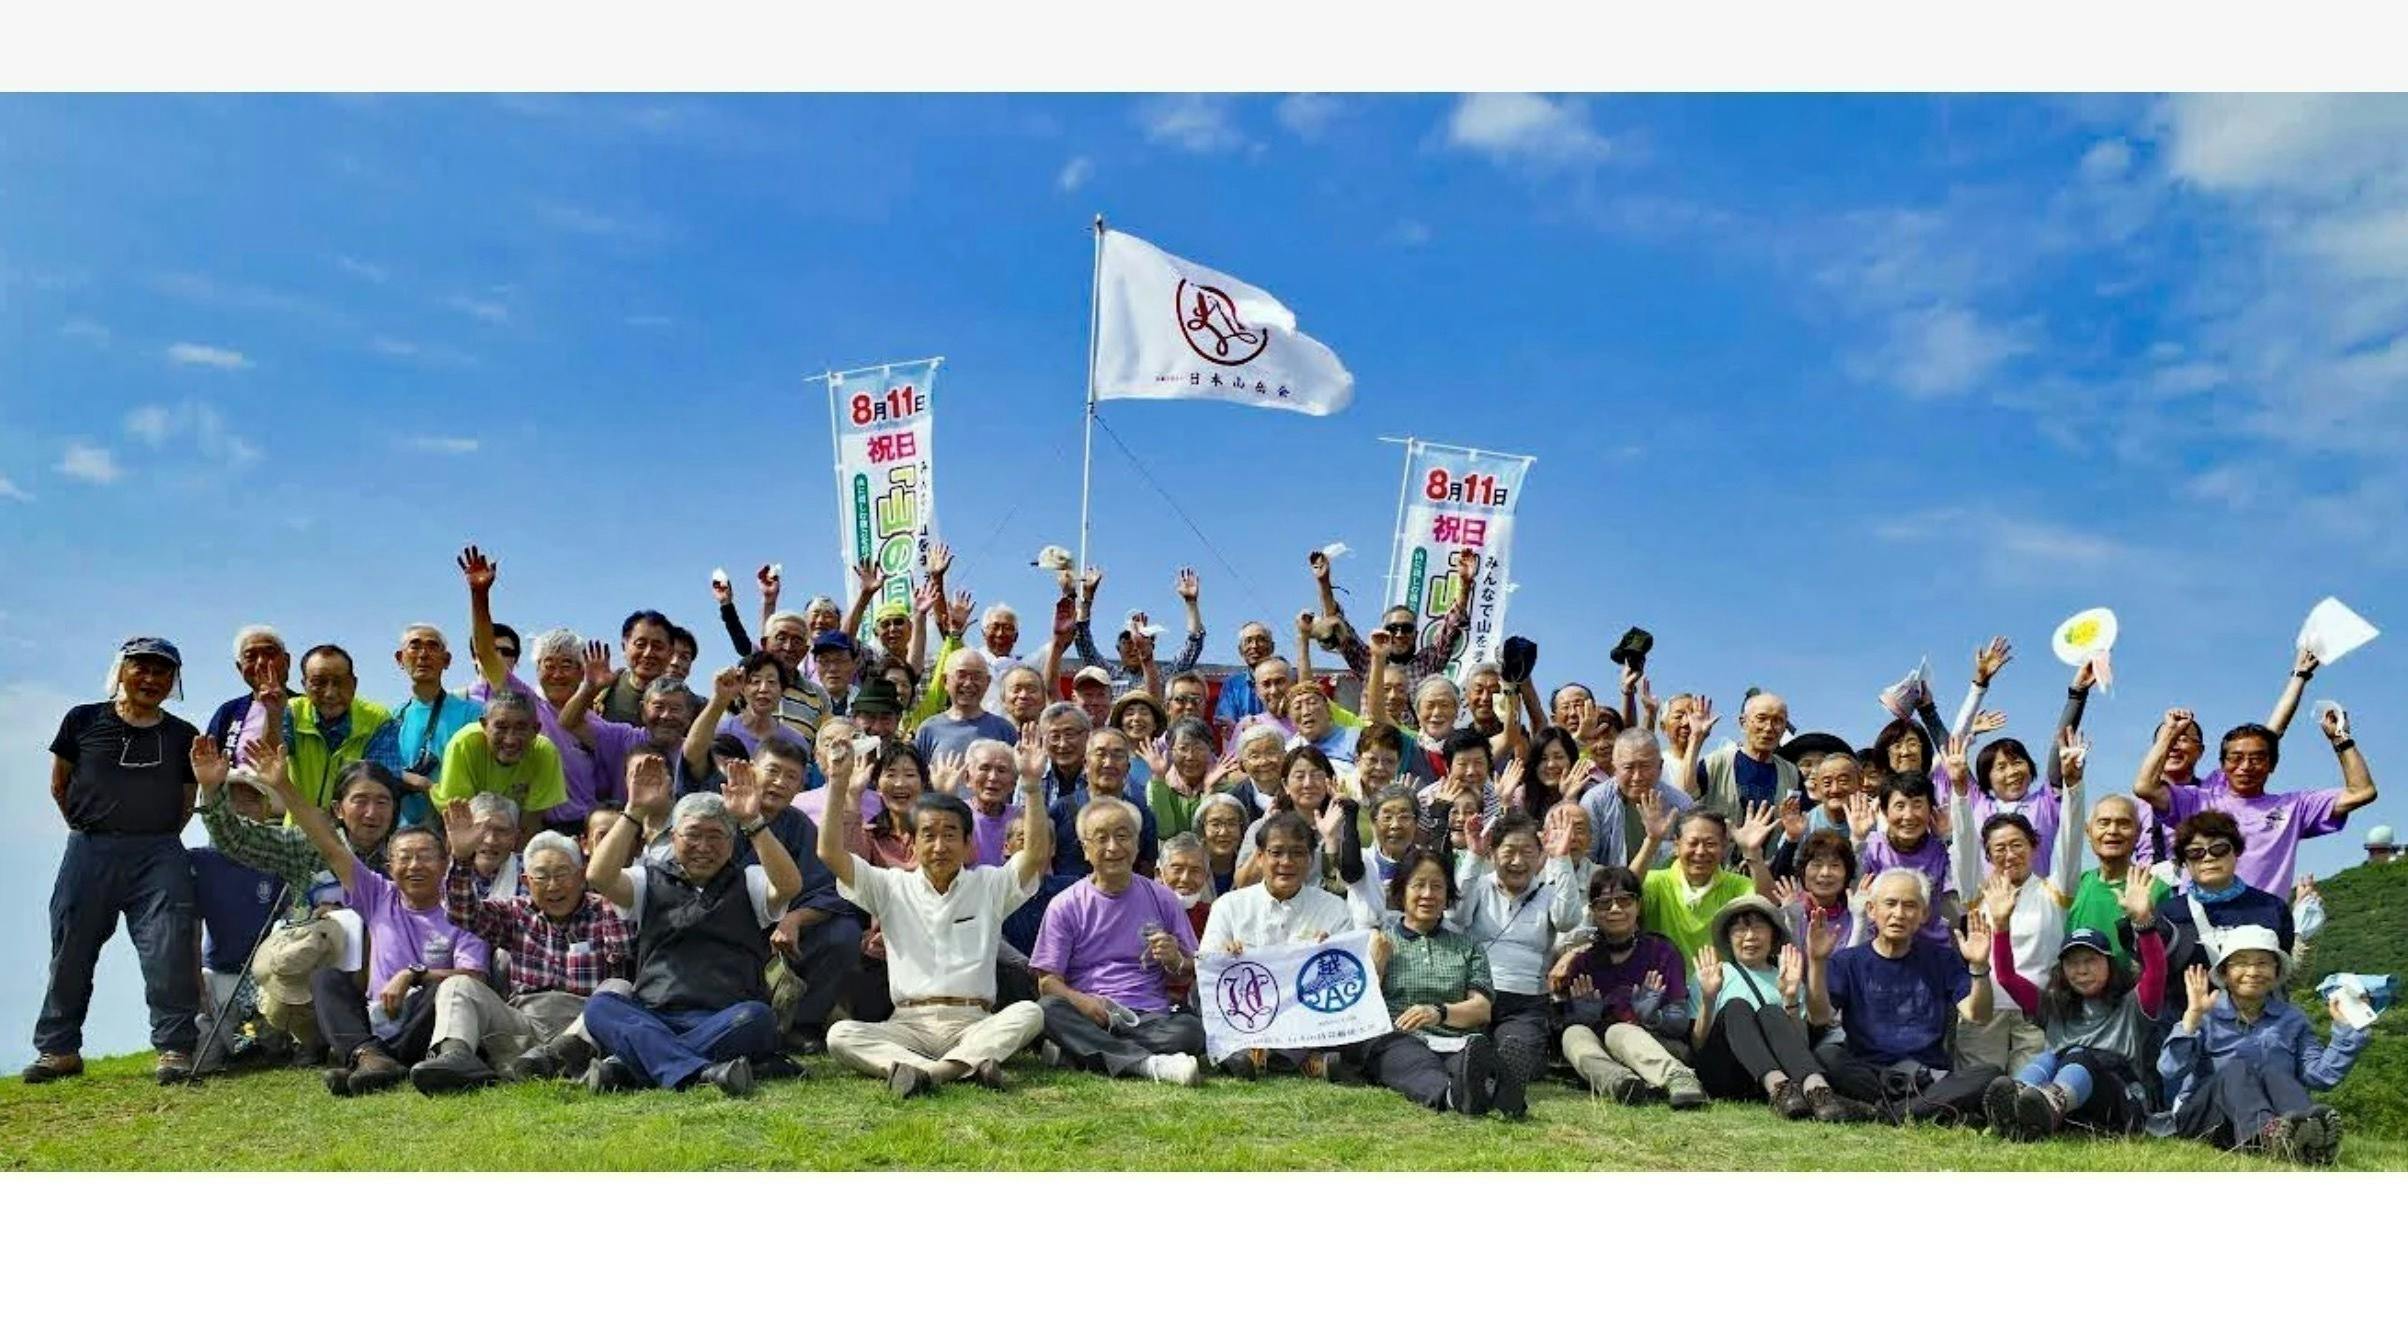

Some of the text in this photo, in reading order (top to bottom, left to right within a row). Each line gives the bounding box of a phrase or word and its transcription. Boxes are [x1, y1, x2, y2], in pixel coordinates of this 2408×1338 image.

[1190, 372, 1290, 398] 日本山岳会
[852, 386, 925, 425] 8月11日
[867, 432, 916, 464] 祝日
[1426, 469, 1508, 506] 8月11日
[1433, 514, 1486, 547] 祝日
